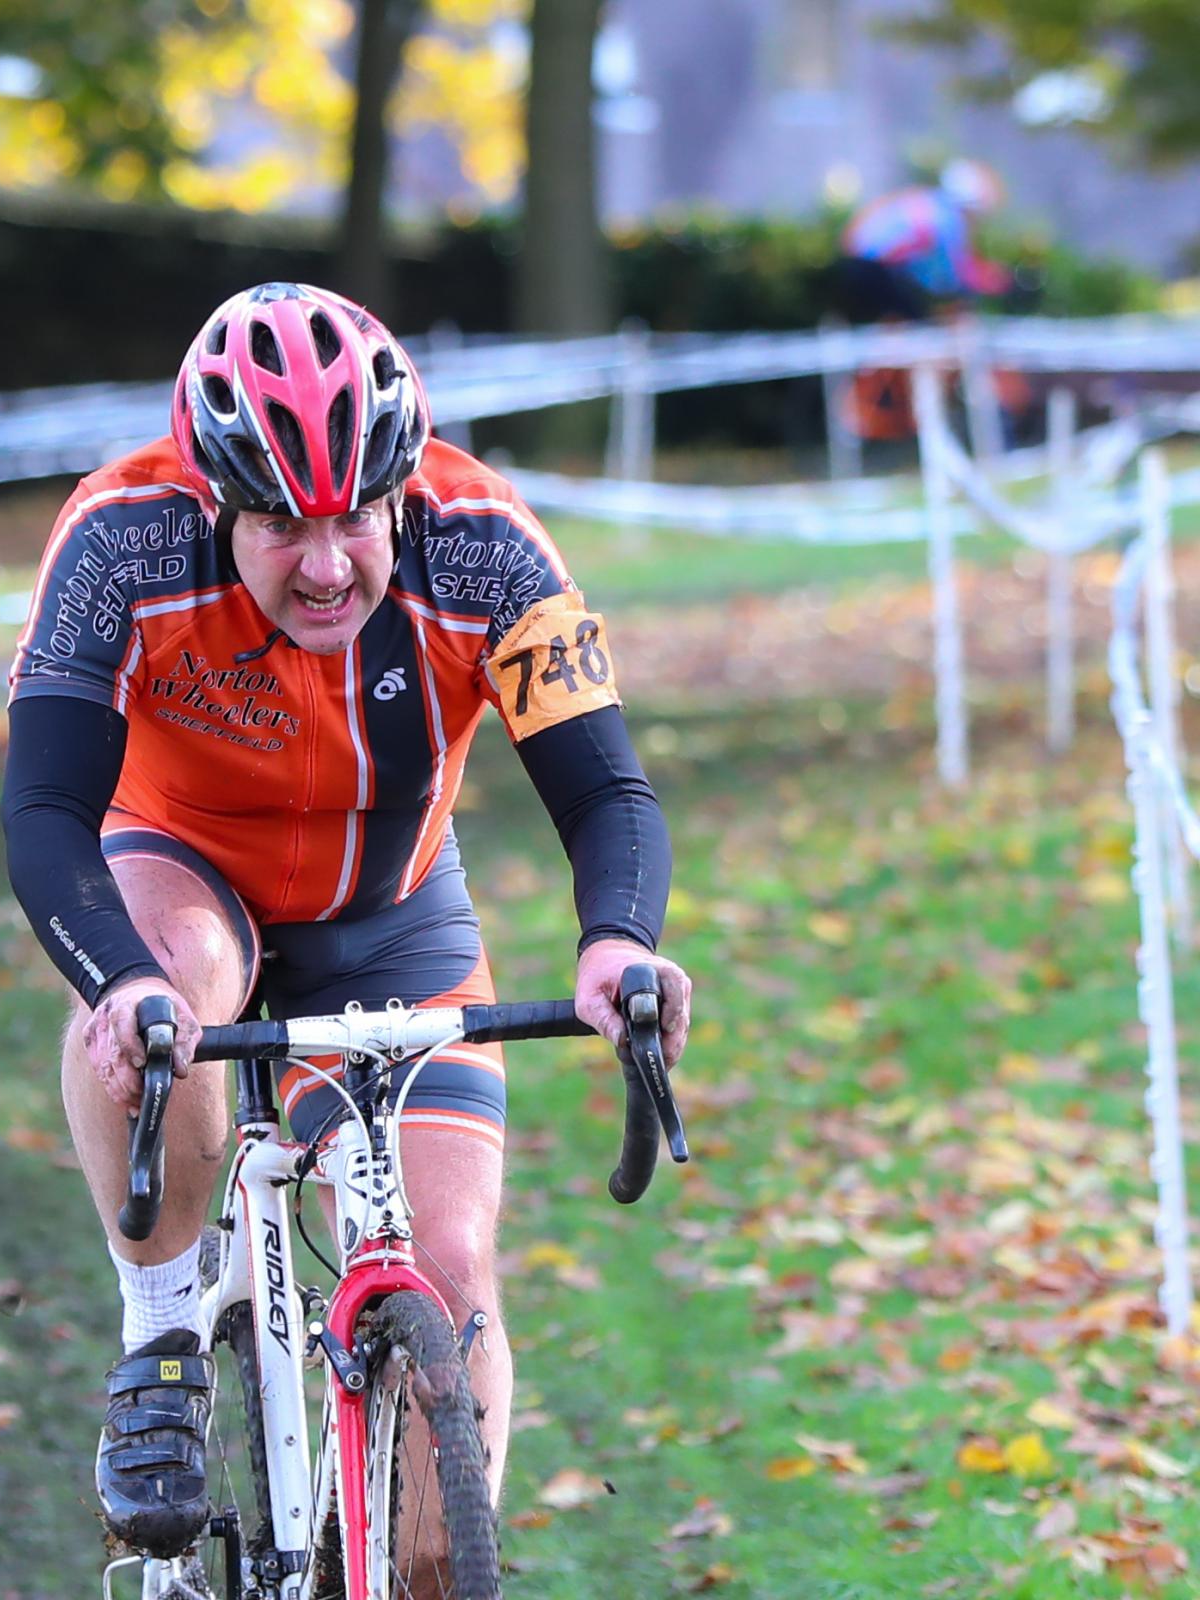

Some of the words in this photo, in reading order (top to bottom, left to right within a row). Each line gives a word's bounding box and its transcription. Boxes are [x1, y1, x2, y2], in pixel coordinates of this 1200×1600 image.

[31, 548, 106, 678] Norton
[150, 677, 299, 736] Wheelers
[168, 649, 284, 697] Norton
[498, 619, 609, 717] 748
[262, 1217, 291, 1358] RIDLEY
